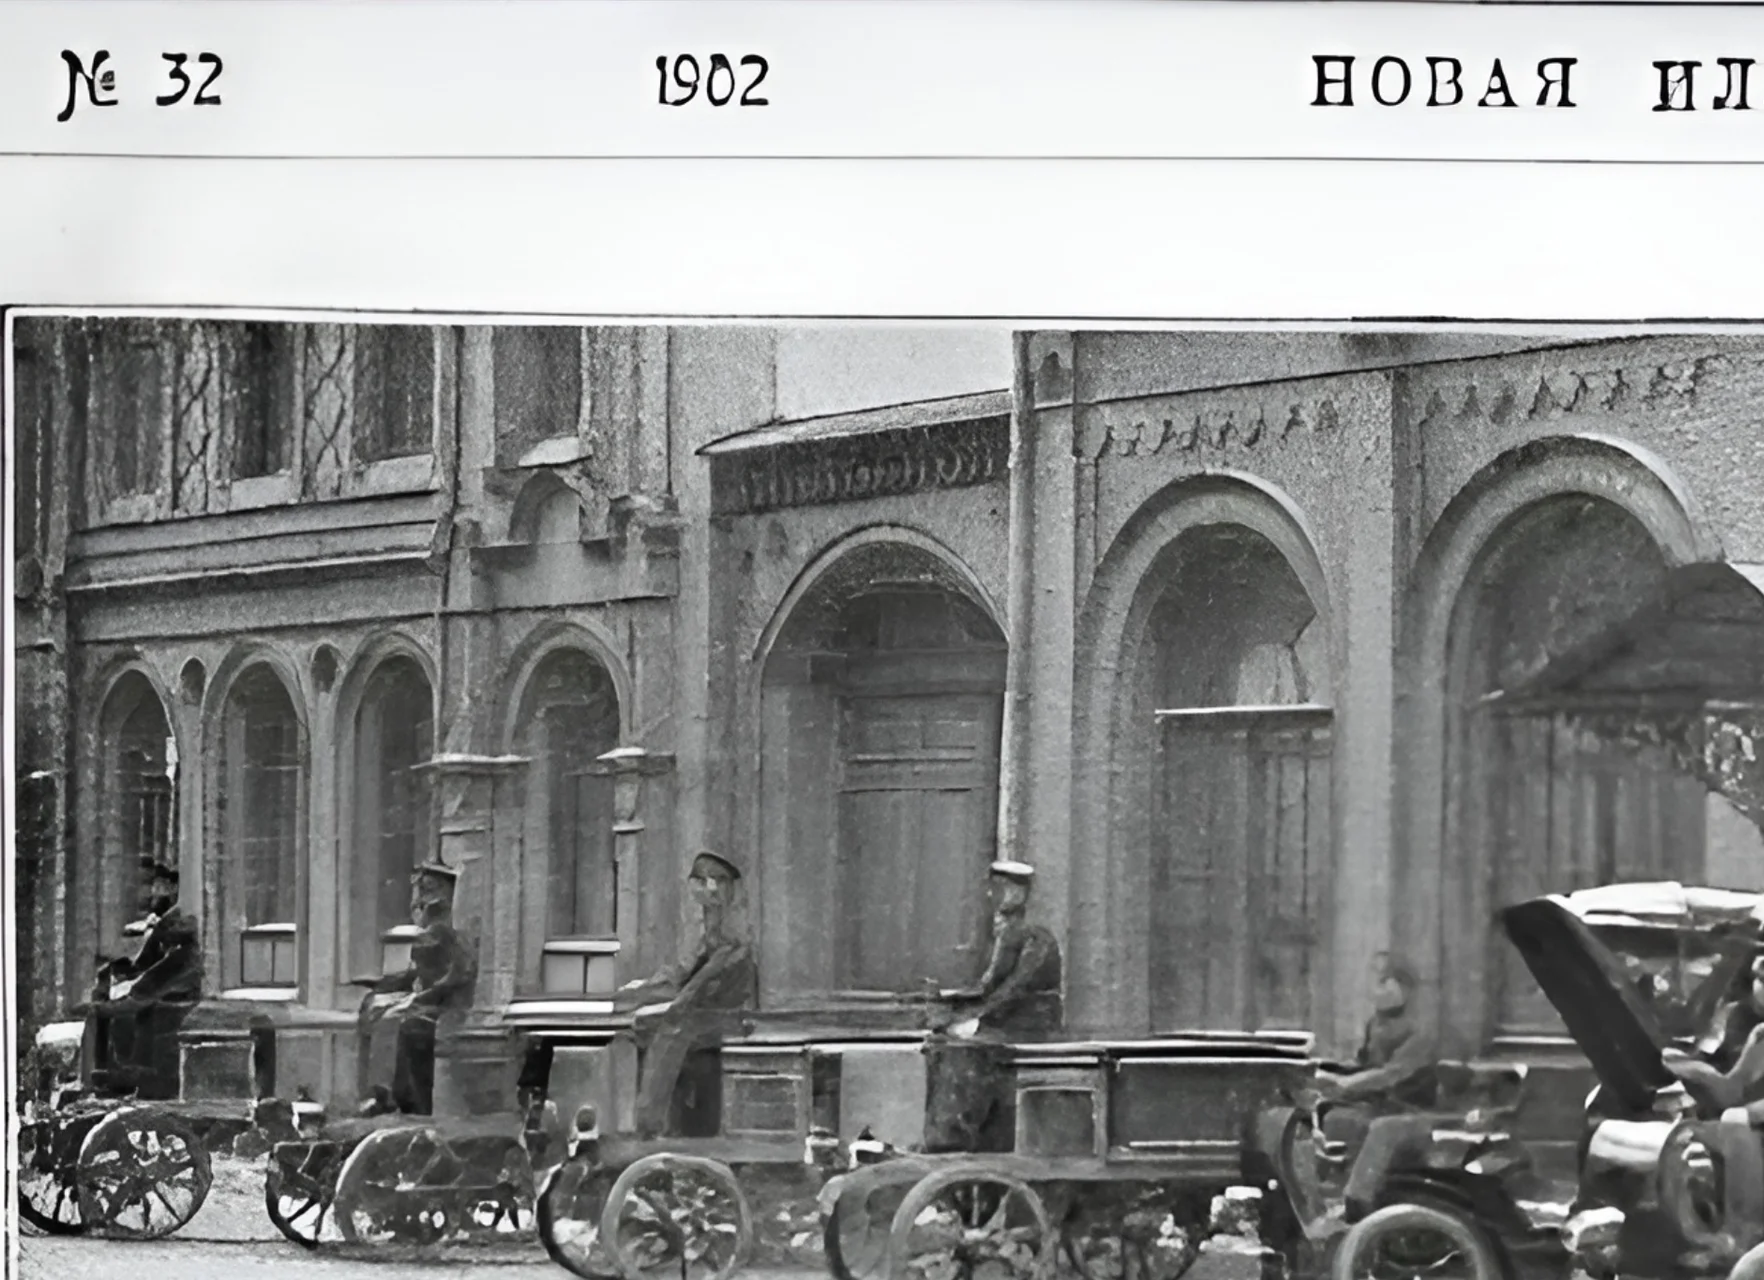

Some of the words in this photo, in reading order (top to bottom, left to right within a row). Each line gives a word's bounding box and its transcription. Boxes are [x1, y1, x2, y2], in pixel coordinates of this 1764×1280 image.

[155, 51, 222, 106] 32
[655, 53, 769, 107] 1902
[1310, 54, 1578, 107] НОВАЯ
